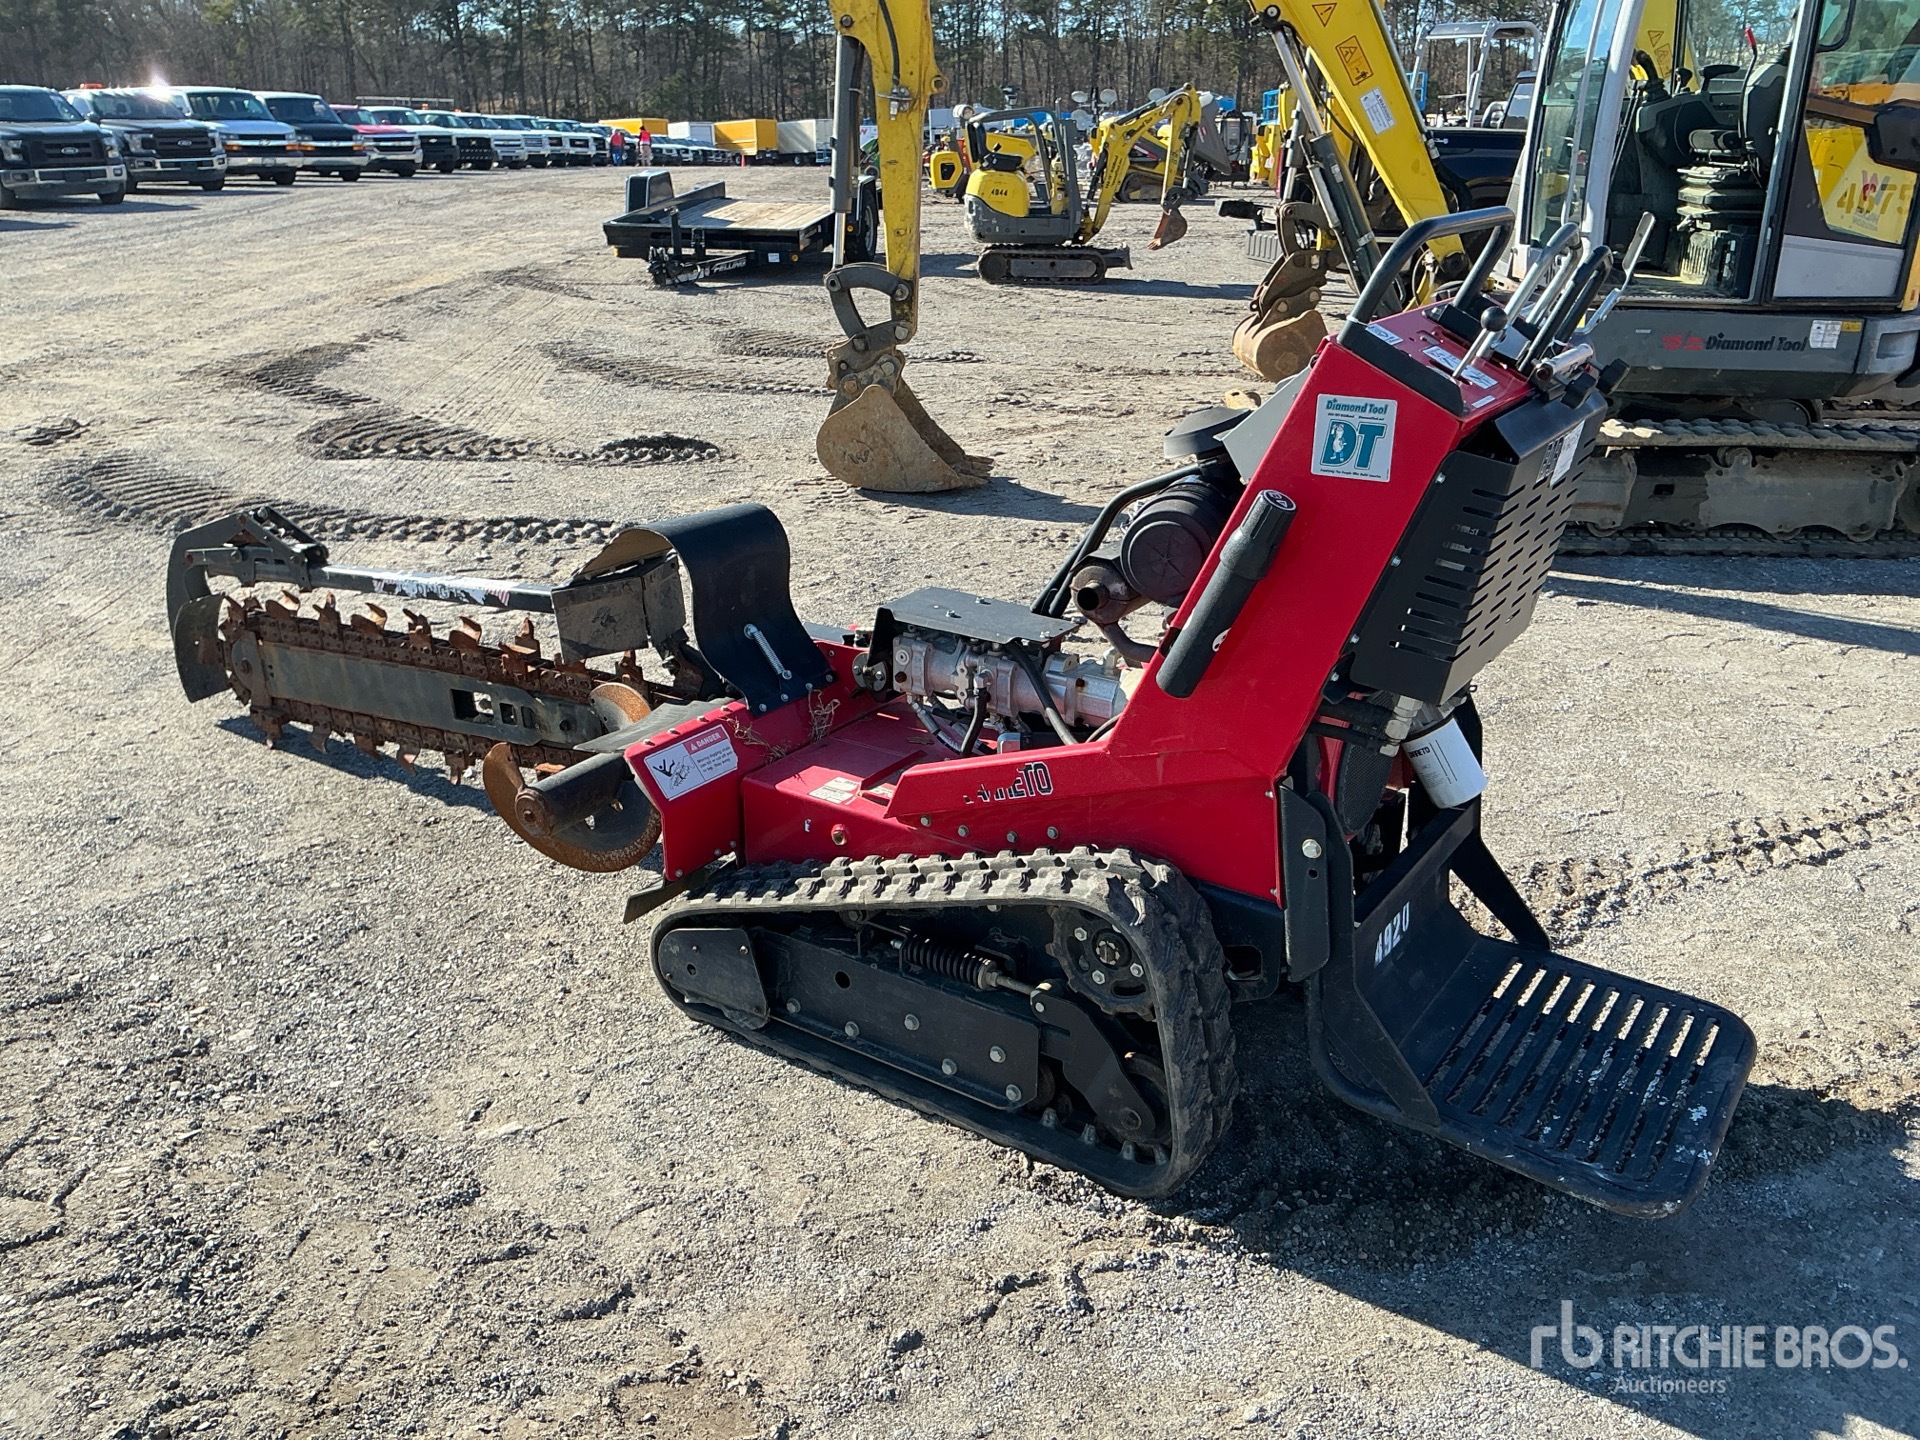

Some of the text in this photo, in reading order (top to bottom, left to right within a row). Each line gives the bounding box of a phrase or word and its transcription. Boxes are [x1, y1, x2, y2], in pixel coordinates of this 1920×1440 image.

[1706, 332, 1808, 352] Diamond Tool
[1326, 398, 1388, 415] Diamond Tool
[1319, 418, 1386, 471] DT
[696, 732, 721, 747] DANGER
[1374, 901, 1410, 968] 4920
